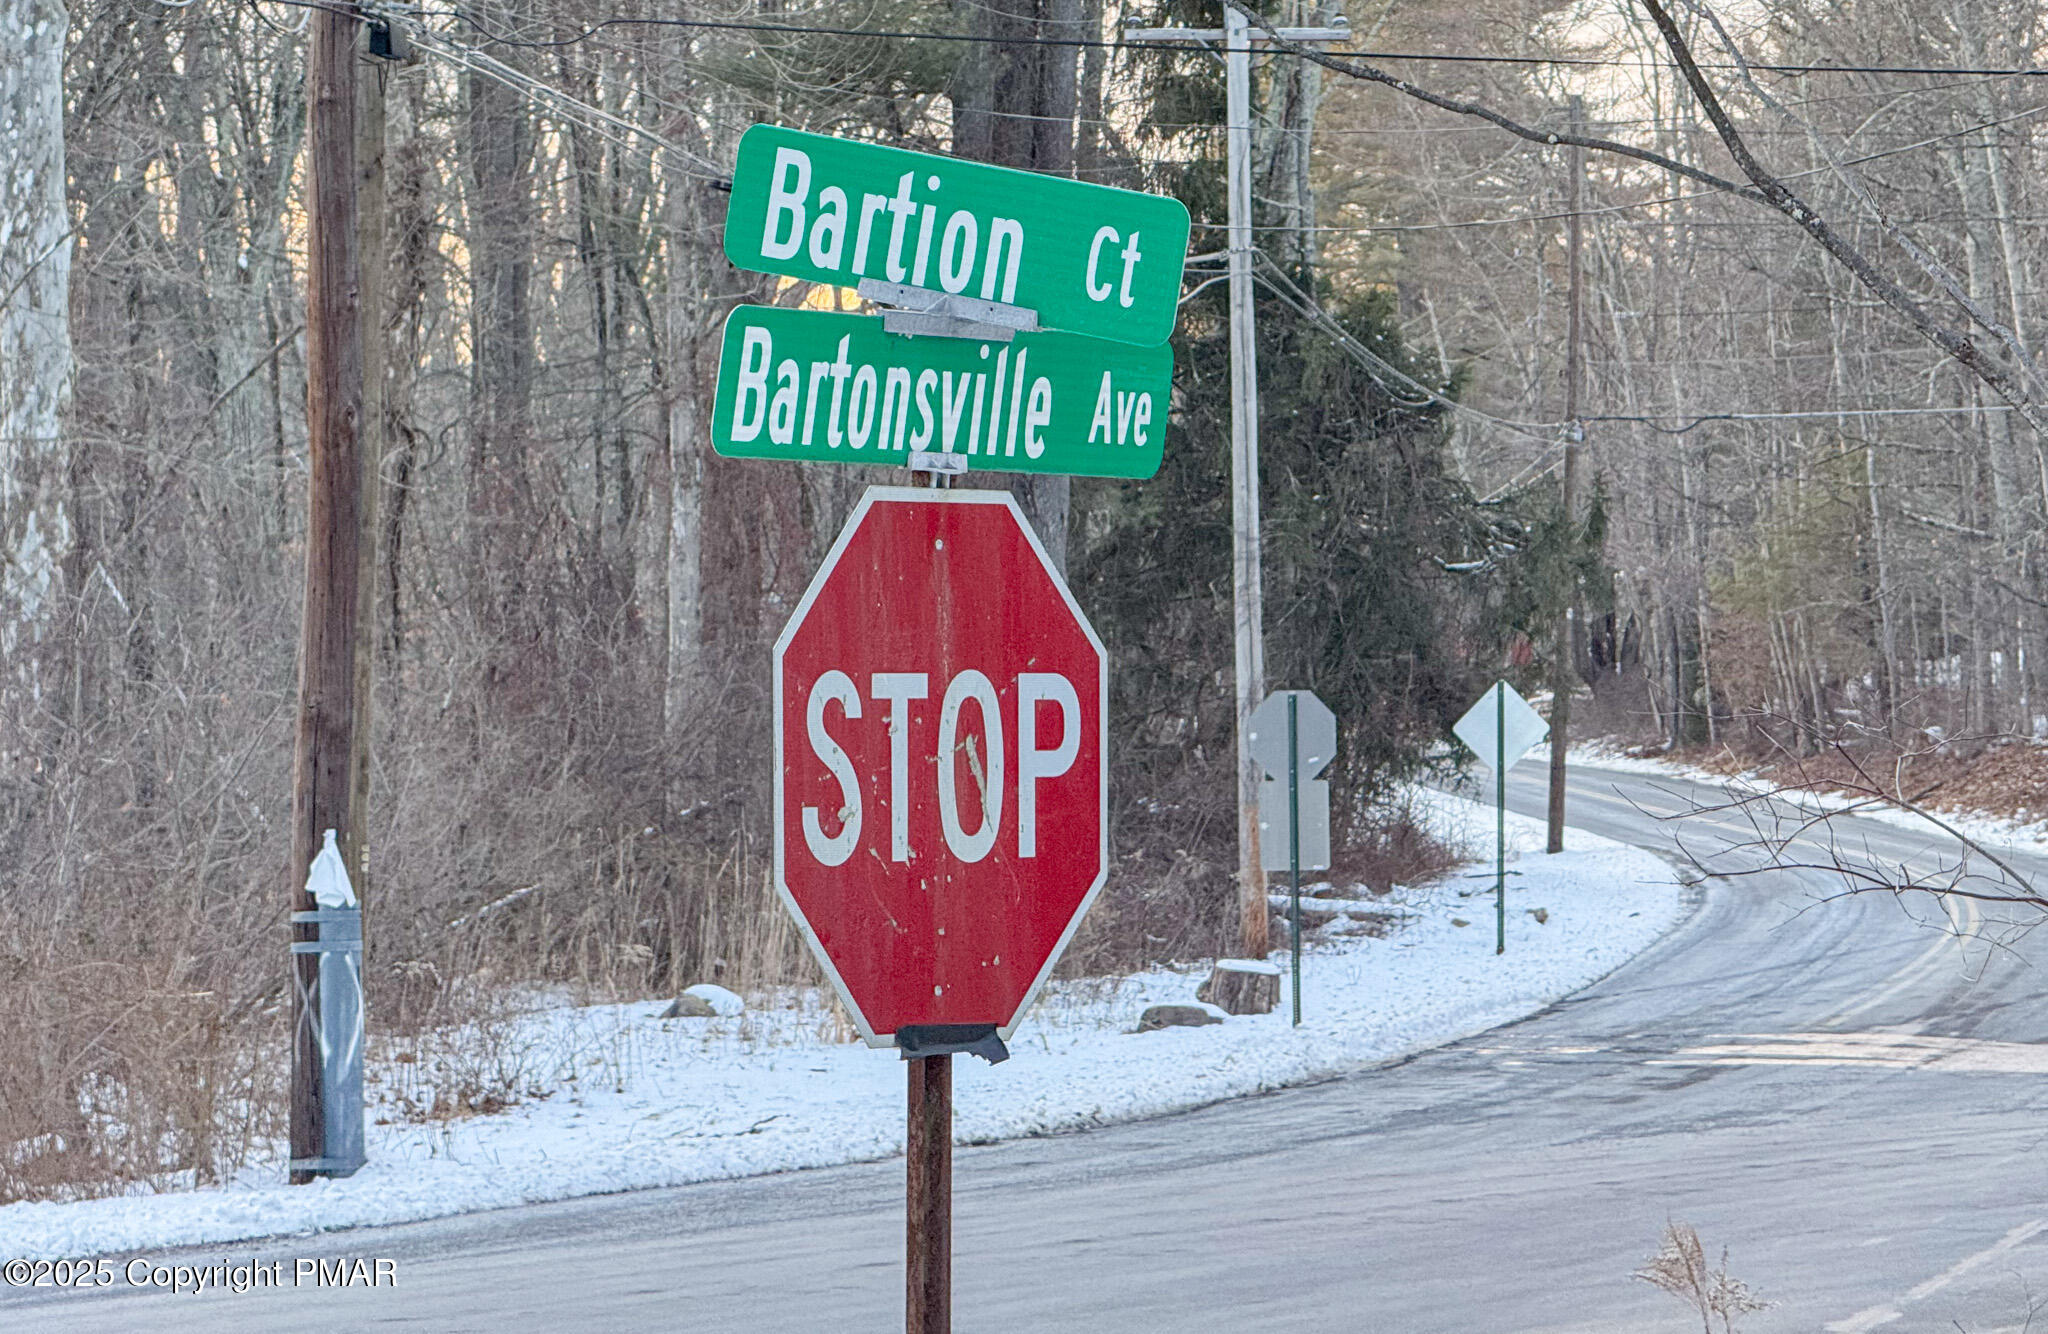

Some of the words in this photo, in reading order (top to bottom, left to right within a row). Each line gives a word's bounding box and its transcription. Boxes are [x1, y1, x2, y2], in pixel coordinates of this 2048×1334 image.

[761, 147, 1024, 304] Bartion
[1086, 226, 1141, 308] Ct
[730, 326, 1052, 459] Bartonsville
[1088, 371, 1152, 447] Ave
[802, 669, 1082, 867] STOP
